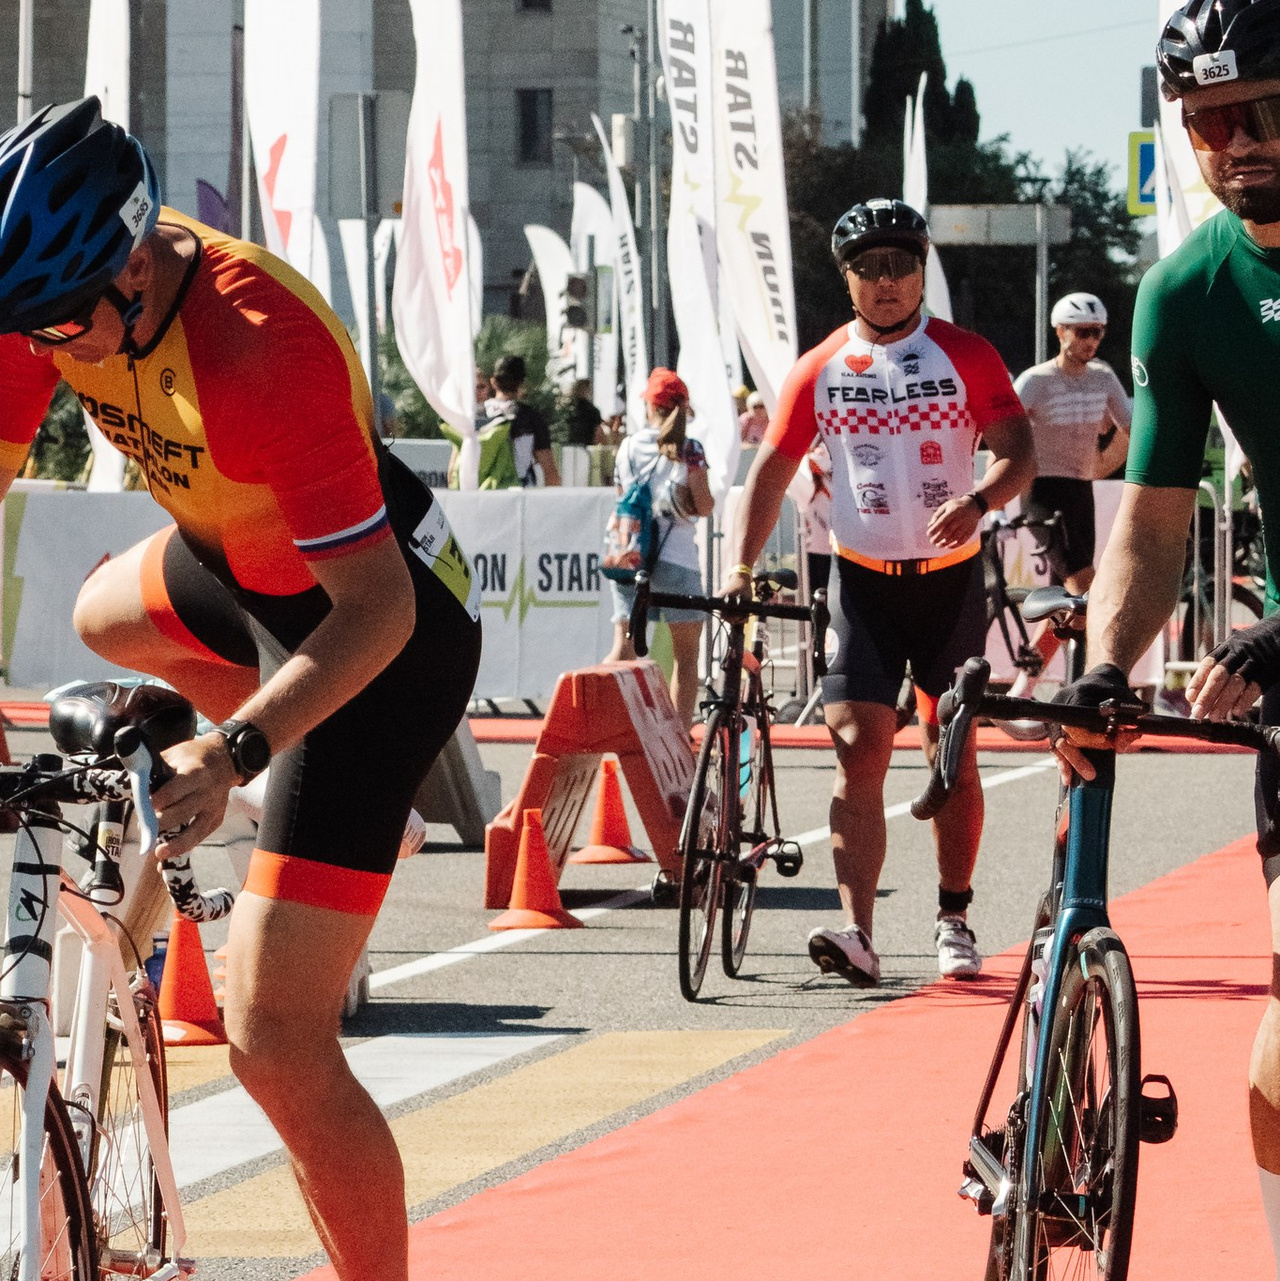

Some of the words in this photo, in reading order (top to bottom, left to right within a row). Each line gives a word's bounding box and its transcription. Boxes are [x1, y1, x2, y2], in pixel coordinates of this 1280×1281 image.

[1201, 64, 1230, 80] 3625
[131, 198, 150, 228] 3685
[826, 377, 958, 406] FEARLESS
[77, 391, 206, 470] OSNEFT
[474, 552, 507, 593] ON
[537, 552, 601, 593] STAR
[104, 844, 122, 858] STA
